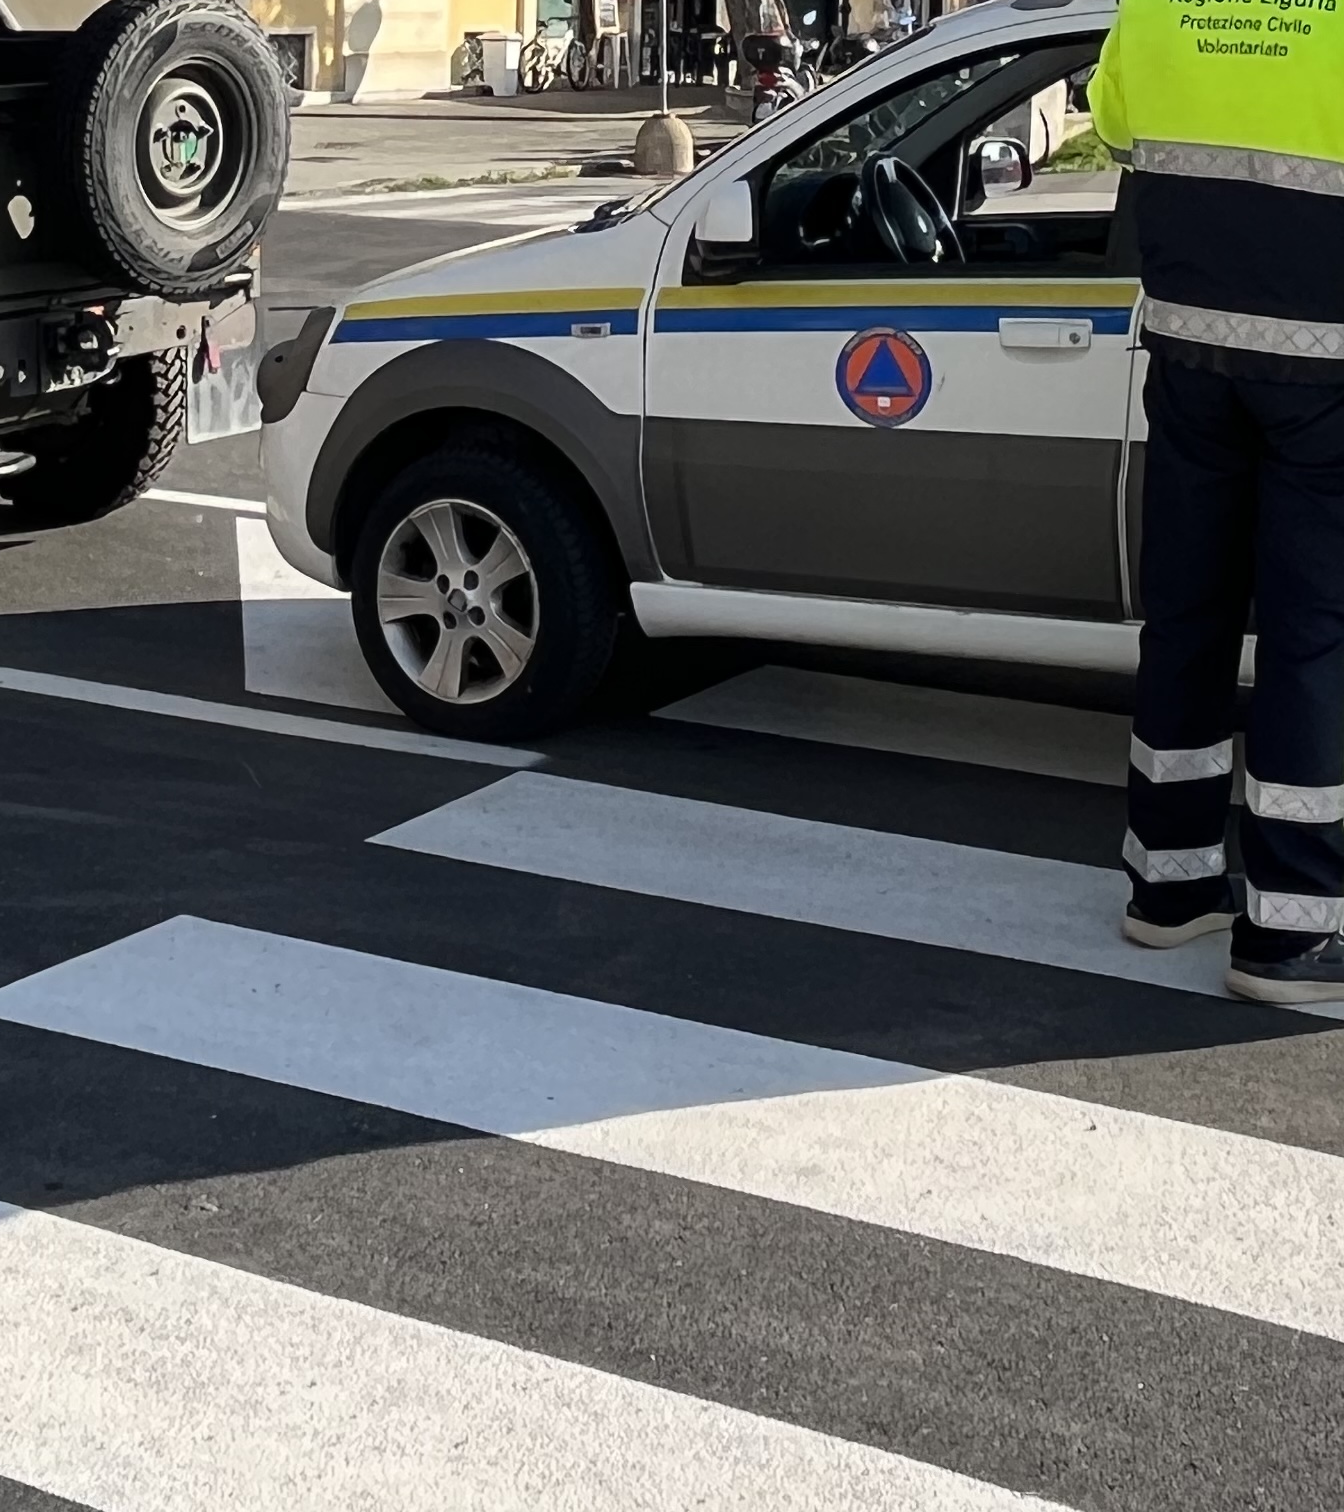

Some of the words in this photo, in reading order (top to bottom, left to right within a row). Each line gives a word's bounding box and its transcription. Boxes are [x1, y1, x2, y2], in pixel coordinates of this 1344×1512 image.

[1180, 14, 1262, 32] Protezione
[1267, 16, 1312, 36] Civile
[1197, 38, 1288, 57] Volontariato
